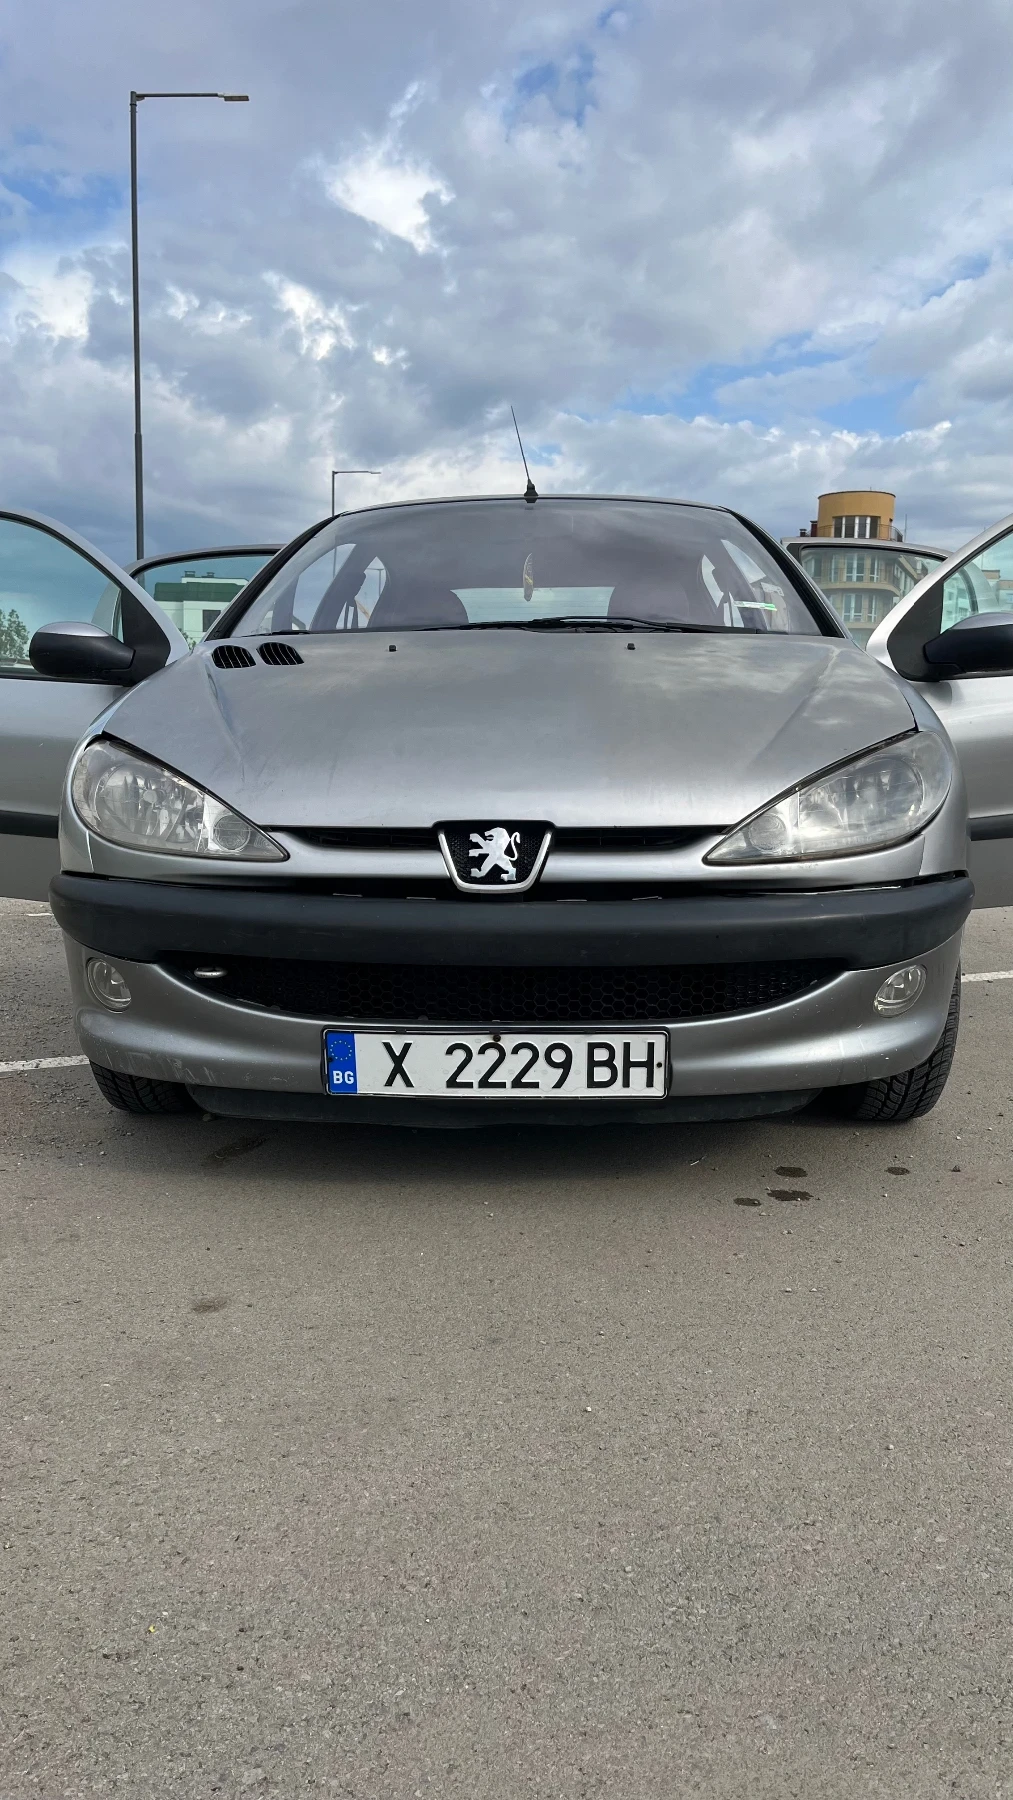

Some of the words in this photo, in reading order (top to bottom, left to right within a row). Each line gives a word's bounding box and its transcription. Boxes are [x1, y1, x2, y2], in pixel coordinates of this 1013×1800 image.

[332, 1070, 355, 1085] BG
[382, 1041, 414, 1088] X
[445, 1041, 574, 1089] 2229
[585, 1041, 656, 1089] BH
